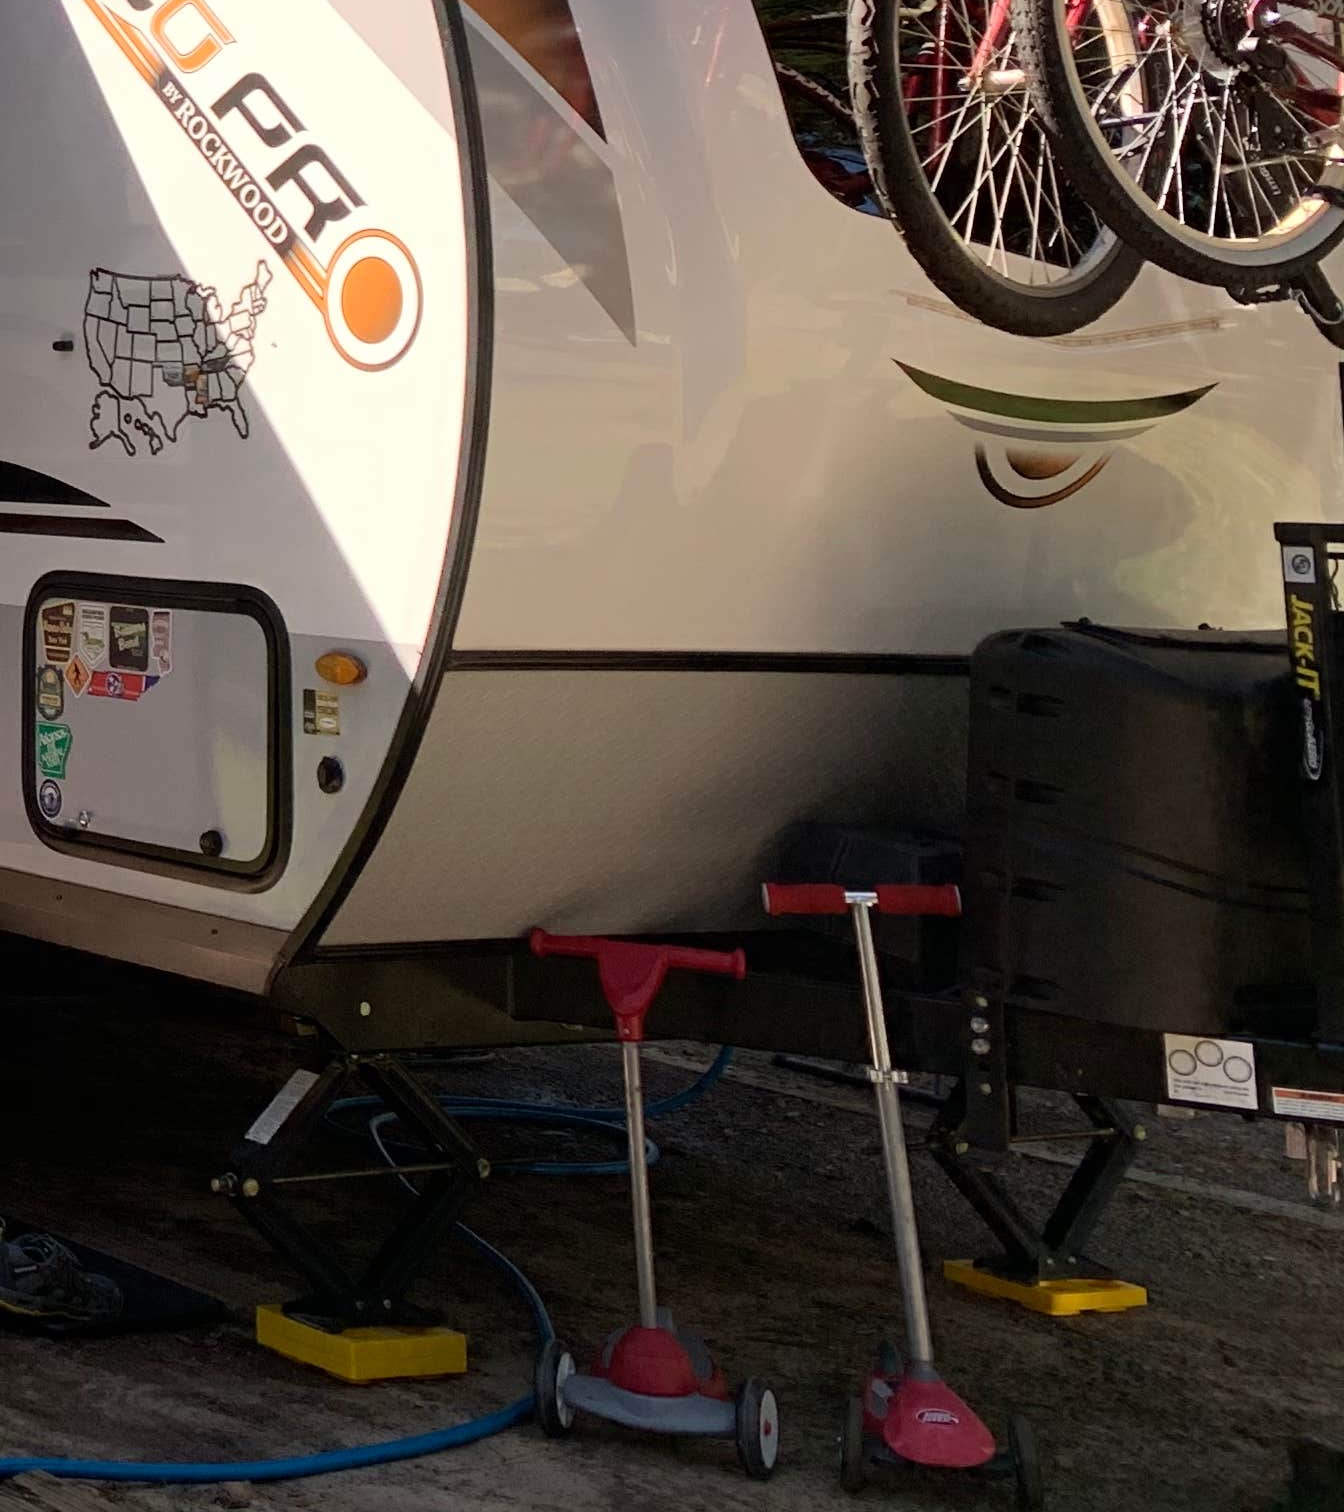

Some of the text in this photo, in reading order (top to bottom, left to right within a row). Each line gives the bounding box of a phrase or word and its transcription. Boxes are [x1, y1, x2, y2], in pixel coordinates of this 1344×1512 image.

[162, 81, 290, 245] BY ROCKWOOD
[1290, 592, 1321, 702] JACK-IT
